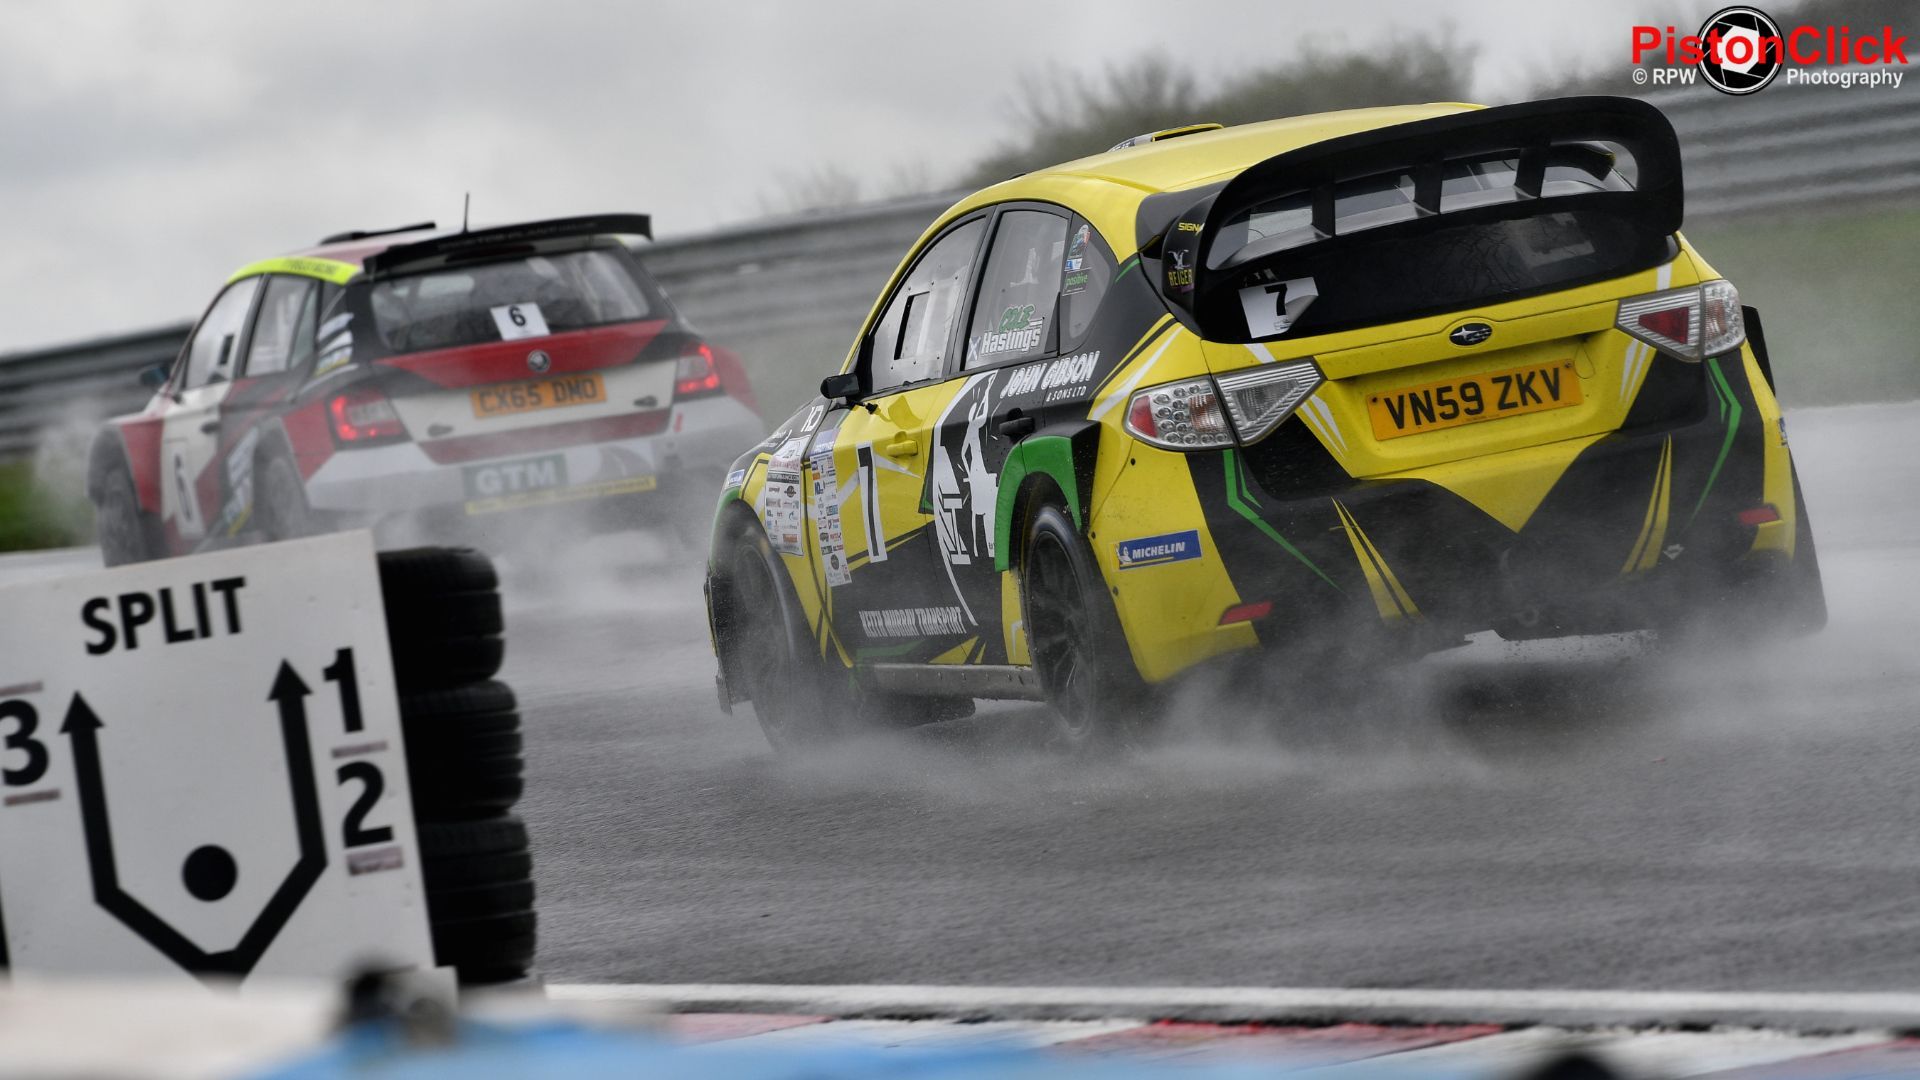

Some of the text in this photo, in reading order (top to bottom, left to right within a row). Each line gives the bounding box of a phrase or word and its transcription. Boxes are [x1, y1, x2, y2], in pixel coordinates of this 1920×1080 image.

[509, 305, 526, 327] 6
[1264, 283, 1287, 316] 7
[981, 329, 1041, 355] Hastings
[1000, 350, 1100, 399] JOHN GIBSON
[477, 387, 542, 414] CX65
[1052, 387, 1071, 401] SONS
[1071, 385, 1087, 398] LTD
[1384, 367, 1561, 430] VN59 ZKV
[475, 461, 558, 495] GTM
[858, 446, 879, 557] 7
[1132, 541, 1186, 560] MICHELIN
[82, 576, 247, 656] SPLIT
[914, 606, 968, 636] TRANSPORT
[322, 646, 364, 734] 1
[0, 699, 49, 787] 3
[336, 761, 394, 849] 2
